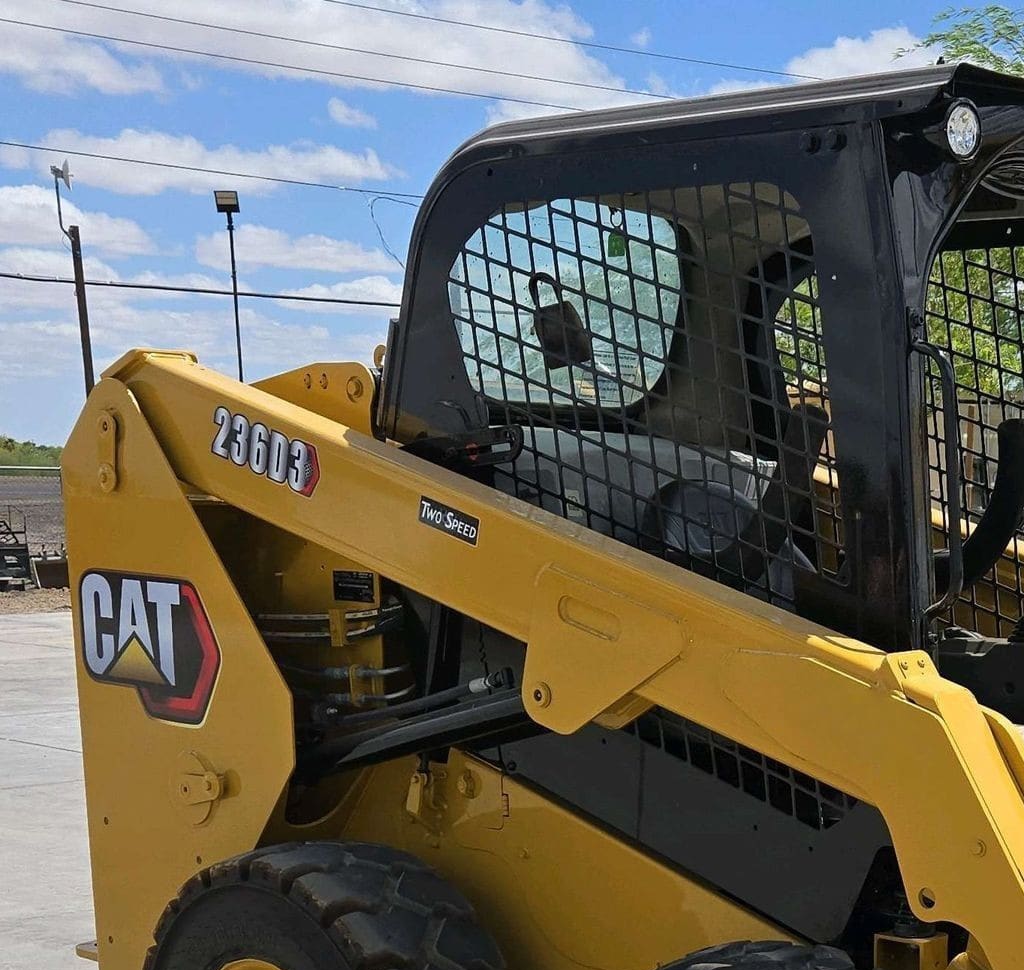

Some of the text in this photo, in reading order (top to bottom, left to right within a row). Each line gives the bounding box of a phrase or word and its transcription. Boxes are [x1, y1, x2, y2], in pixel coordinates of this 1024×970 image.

[212, 406, 309, 493] 236D3
[421, 500, 477, 538] TWO SPEED
[81, 573, 181, 687] CAT
